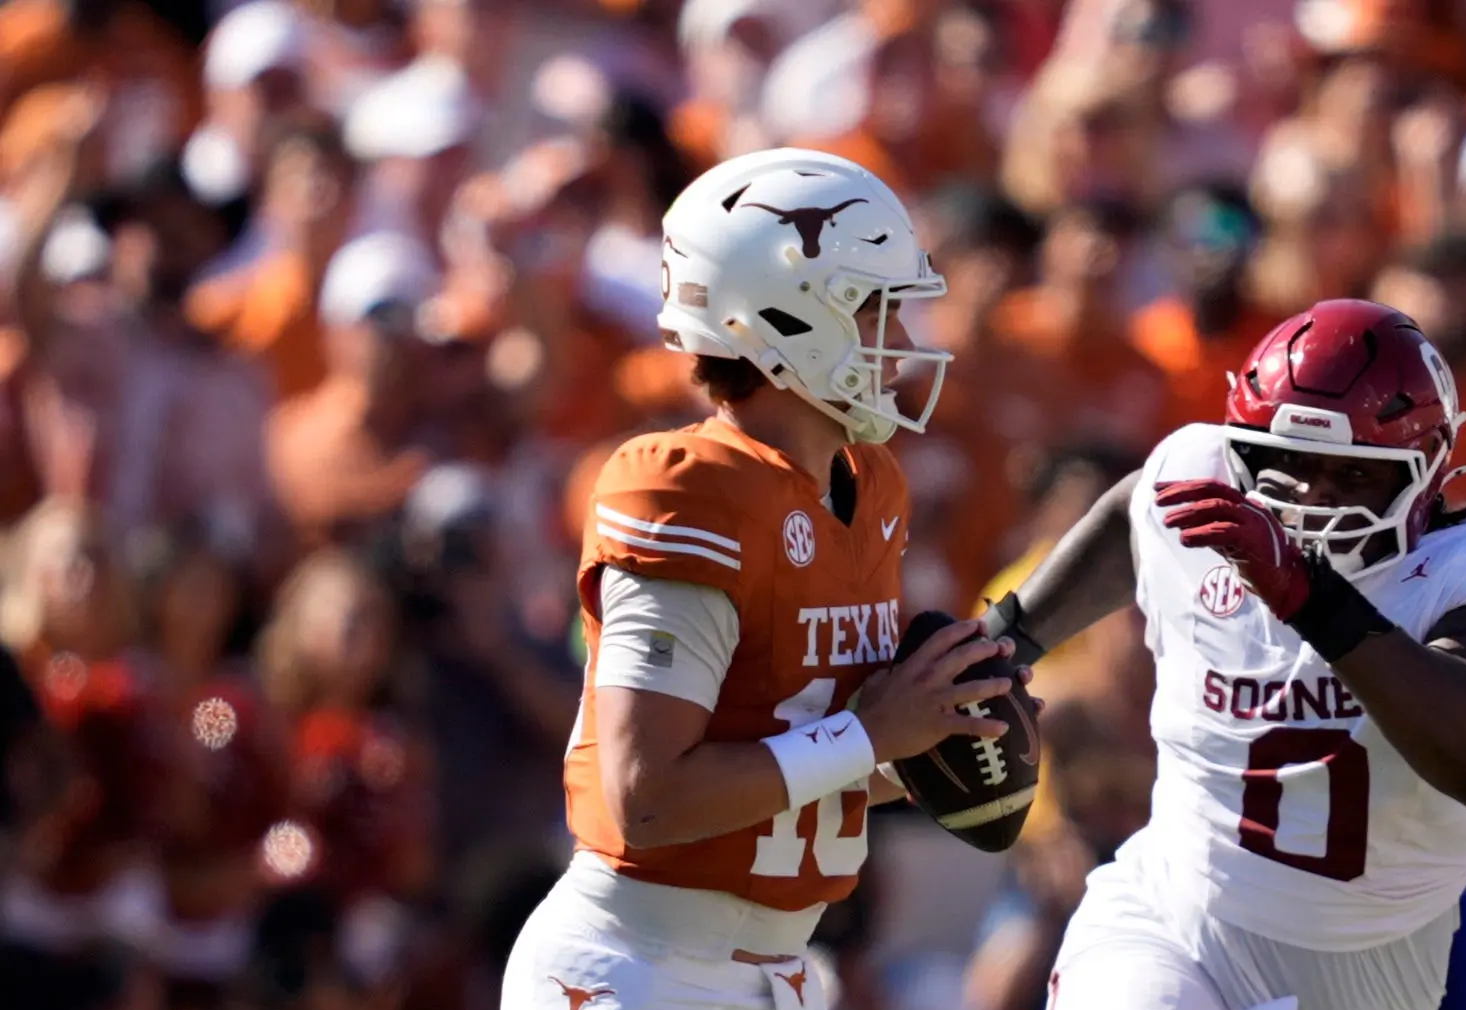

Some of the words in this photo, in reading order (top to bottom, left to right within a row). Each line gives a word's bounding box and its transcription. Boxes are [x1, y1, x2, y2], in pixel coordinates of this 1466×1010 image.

[784, 511, 815, 567] SEC
[1201, 565, 1243, 616] SEC
[1203, 669, 1364, 721] SOONE
[1238, 727, 1370, 882] 0
